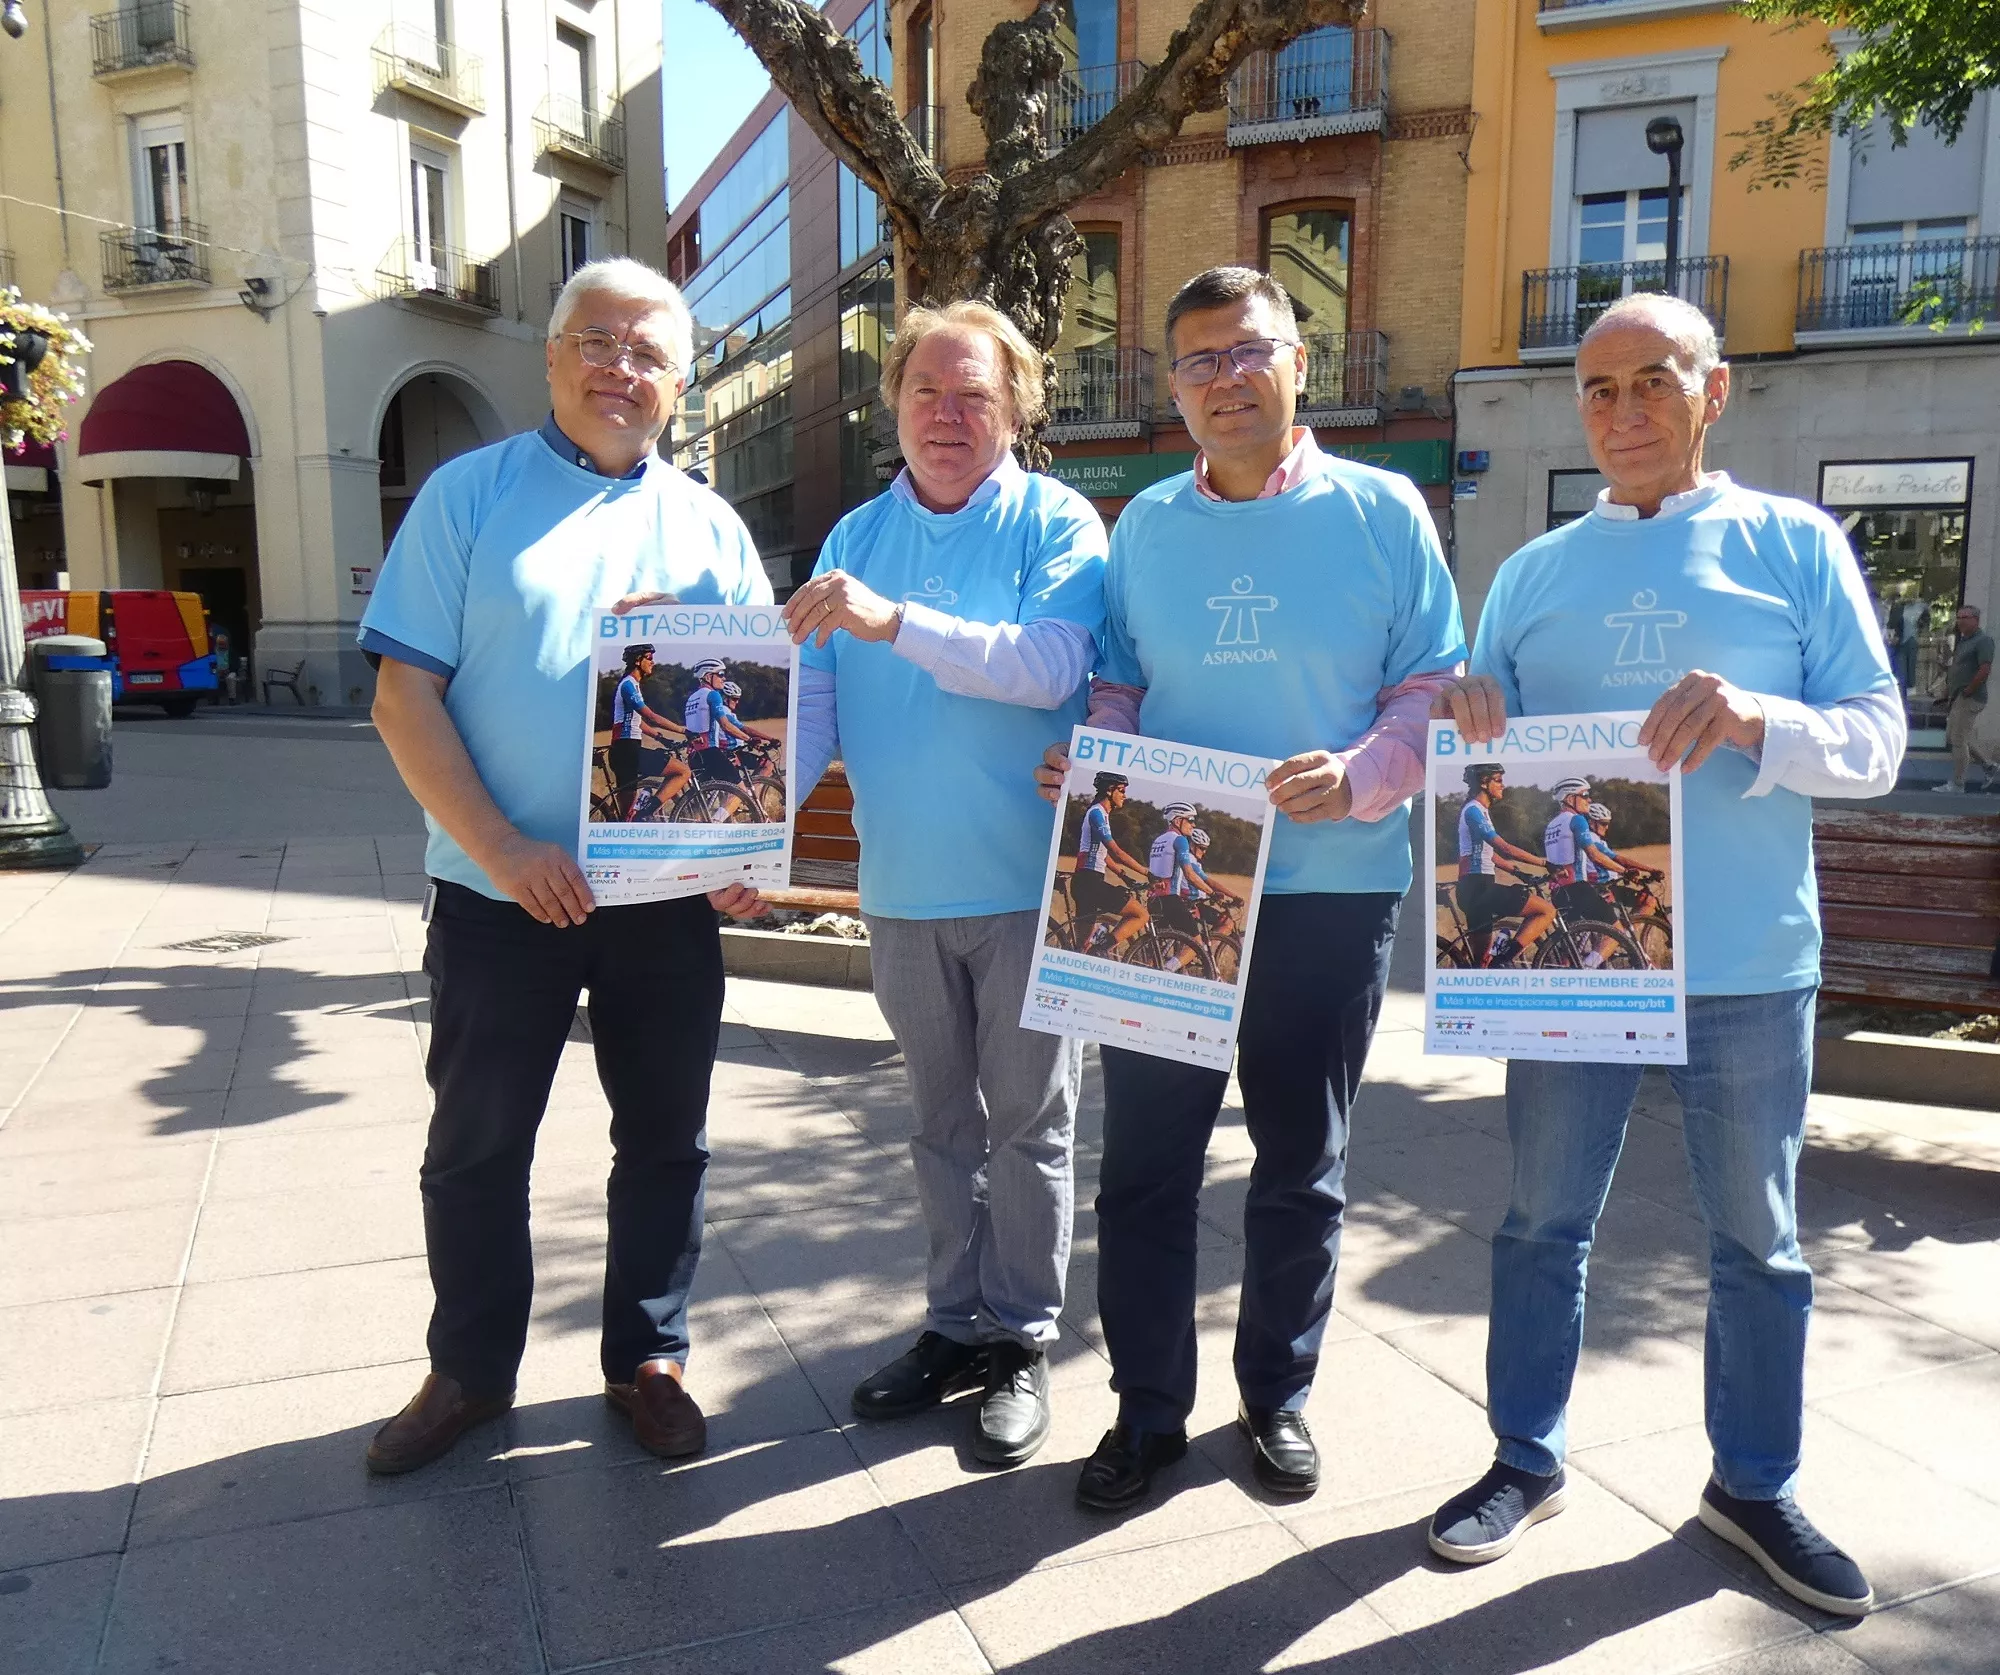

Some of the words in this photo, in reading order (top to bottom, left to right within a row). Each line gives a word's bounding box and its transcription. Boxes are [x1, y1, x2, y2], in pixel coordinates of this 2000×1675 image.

[1051, 468, 1080, 480] CAJA
[1083, 465, 1126, 479] RURAL
[1074, 478, 1118, 491] ARAGÓN
[1828, 475, 1887, 496] Pilar
[1896, 473, 1962, 494] Prieto
[1202, 648, 1278, 665] ASPANOA
[588, 826, 659, 838] ALMUDÉVAR
[668, 829, 680, 839] 21
[684, 829, 758, 838] SEPTIEMBRE
[761, 828, 786, 837] 2024
[612, 847, 628, 855] info
[706, 841, 777, 855] aspanoa.org/btt
[1041, 952, 1111, 975] ALMUDÉVAR
[1119, 969, 1130, 979] 21
[1134, 972, 1207, 994] SEPTIEMBRE
[1210, 987, 1236, 1000] 2024
[1436, 974, 1520, 987] ALMUDÉVAR
[1531, 977, 1545, 987] 21
[1550, 977, 1639, 988] SEPTIEMBRE
[1643, 977, 1675, 988] 2024
[1064, 974, 1079, 986] info
[1140, 993, 1152, 1001] en
[1152, 995, 1226, 1016] aspanoa.org/btt
[1466, 996, 1484, 1005] info
[1561, 999, 1574, 1007] en
[1576, 998, 1666, 1010] aspanoa.org/btt
